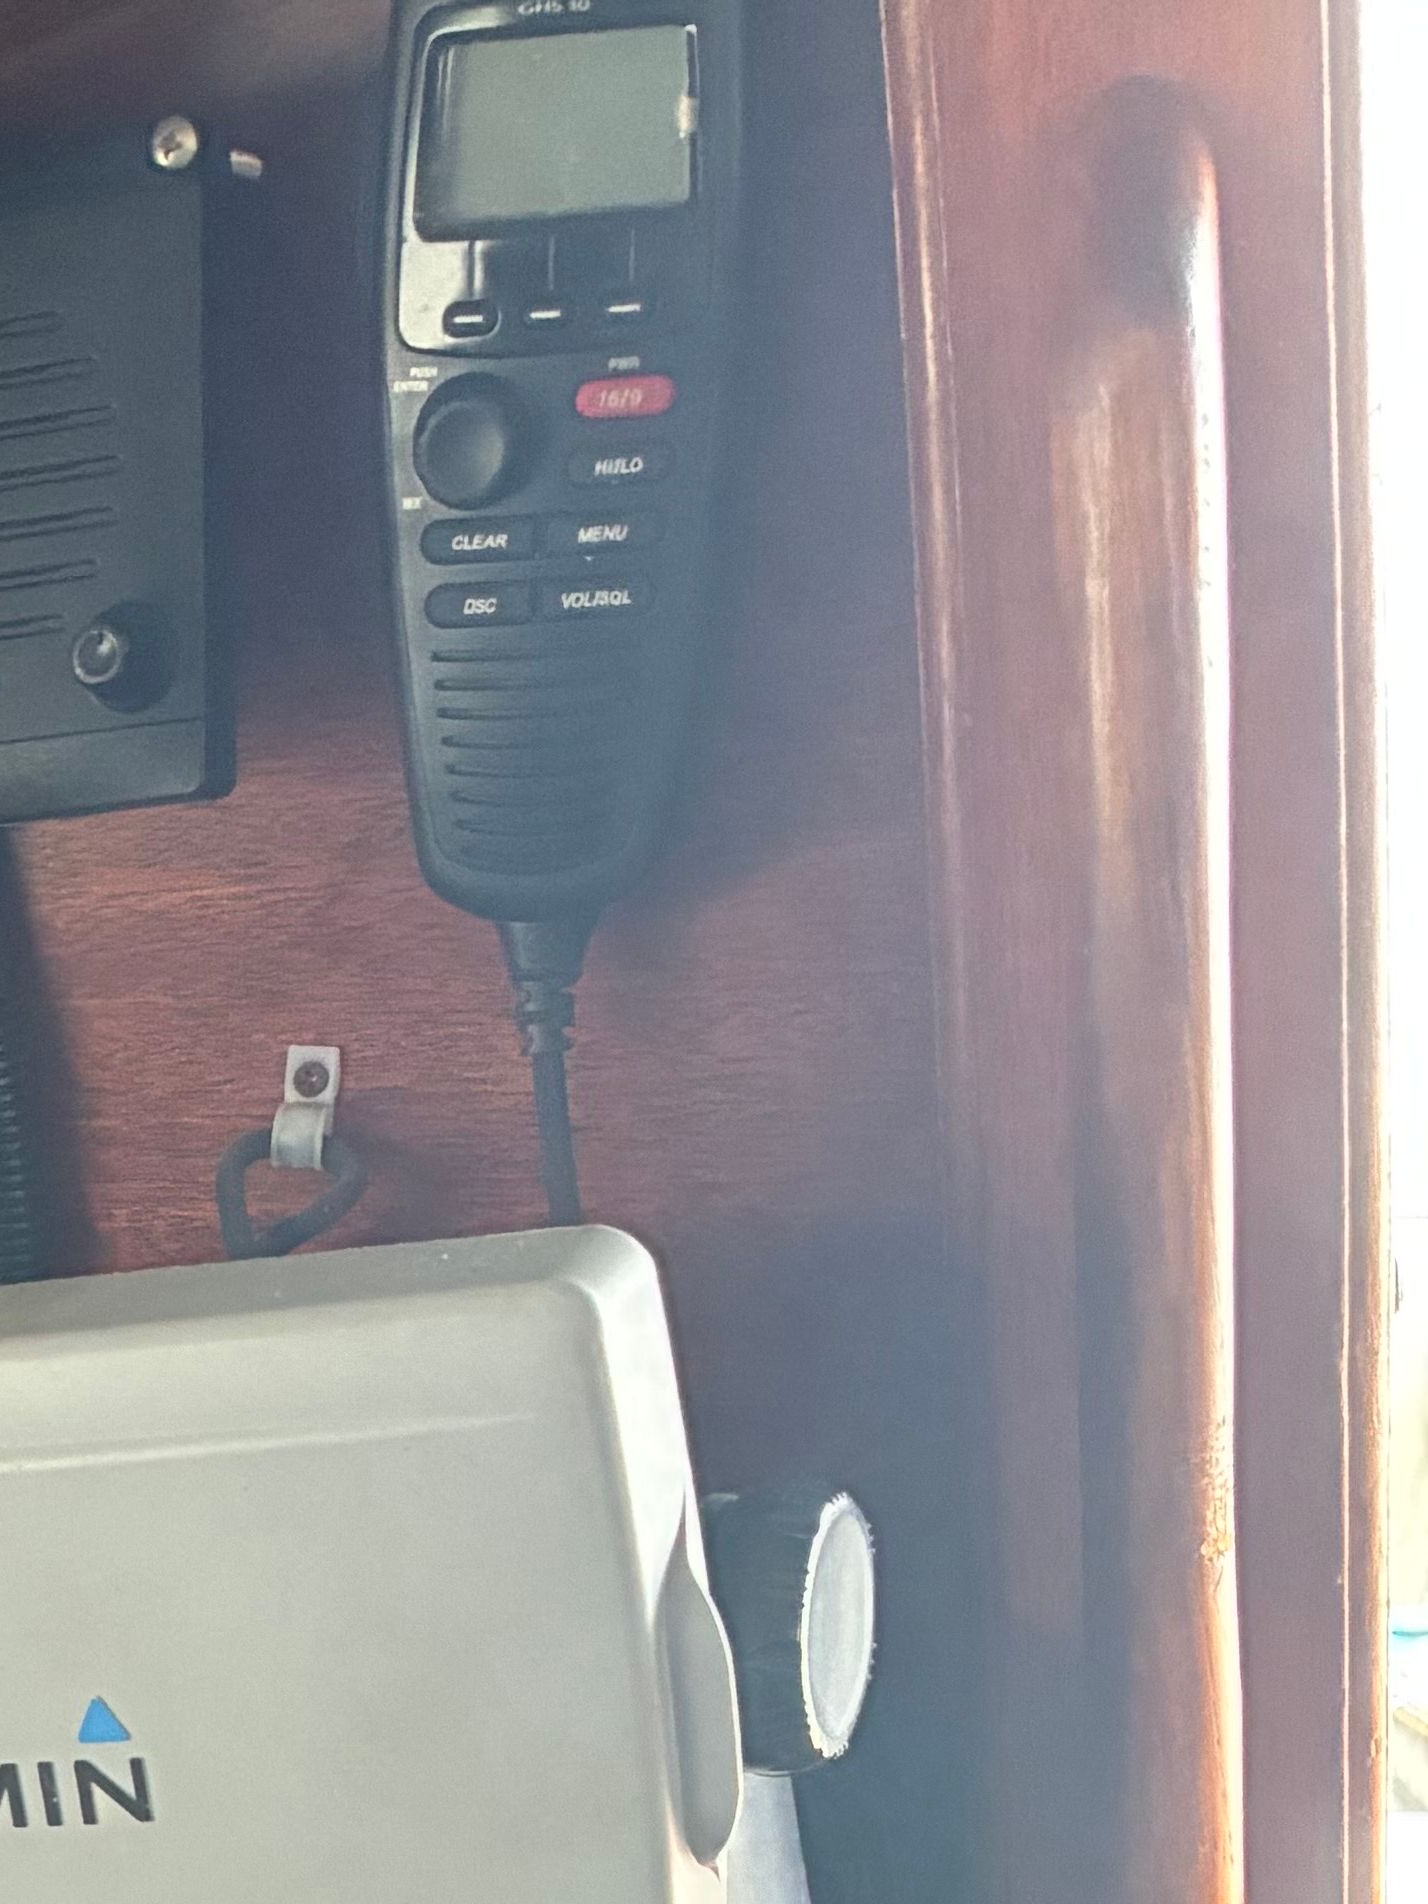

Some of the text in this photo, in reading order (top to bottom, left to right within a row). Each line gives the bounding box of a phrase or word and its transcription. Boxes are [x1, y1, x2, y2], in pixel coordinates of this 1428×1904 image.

[451, 533, 509, 551] CLEAR
[577, 525, 629, 544] MENU
[463, 598, 498, 615] DSC
